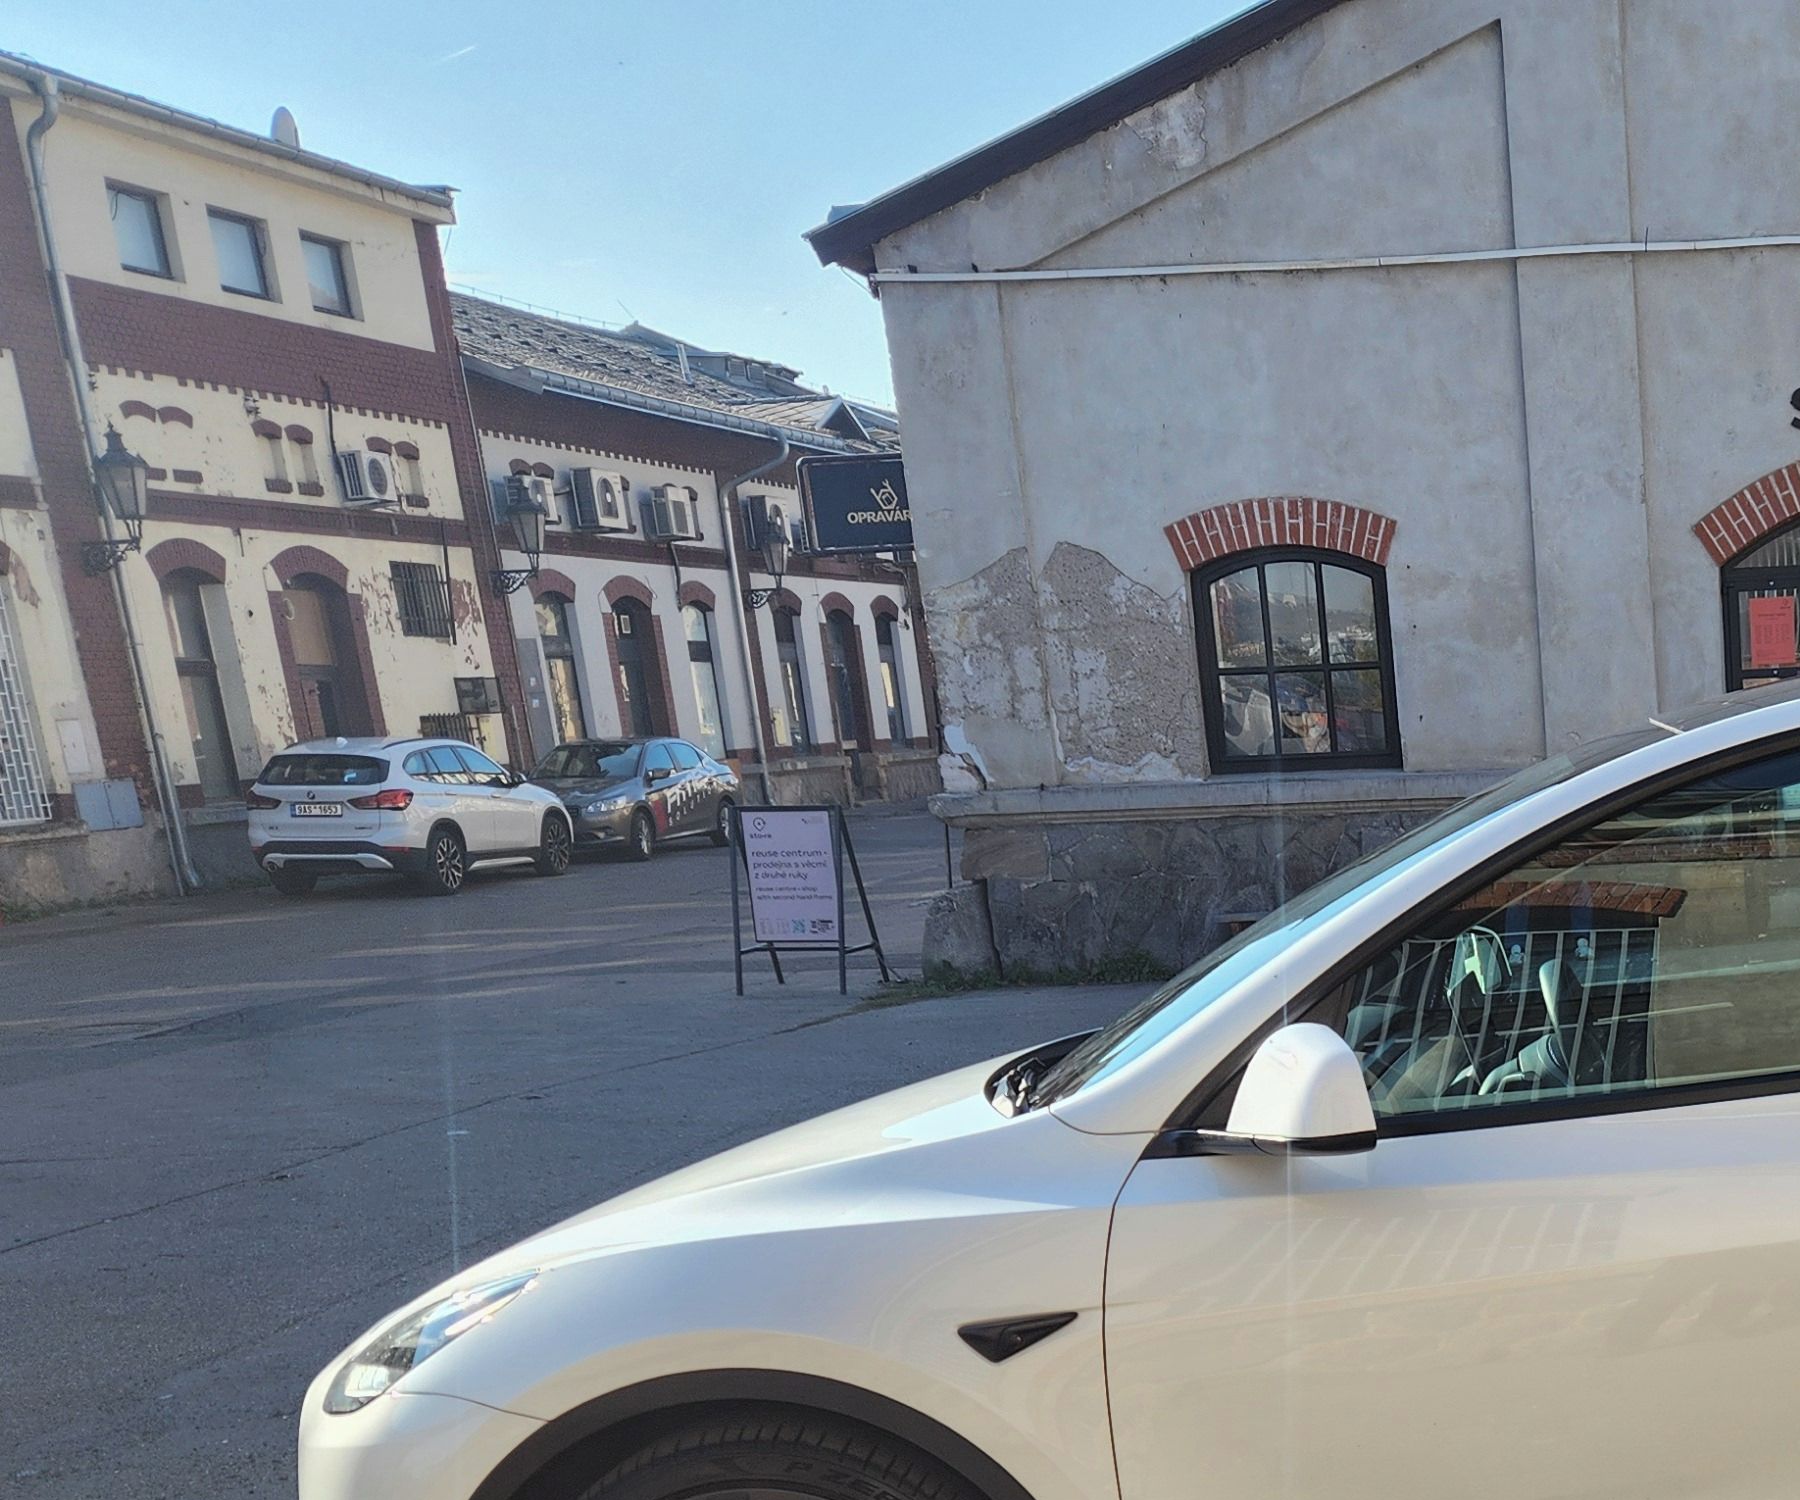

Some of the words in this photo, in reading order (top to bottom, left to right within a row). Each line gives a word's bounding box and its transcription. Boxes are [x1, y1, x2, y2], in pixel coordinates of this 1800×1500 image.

[297, 804, 313, 814] 9AS
[751, 850, 779, 858] reuse
[780, 849, 822, 858] centrum
